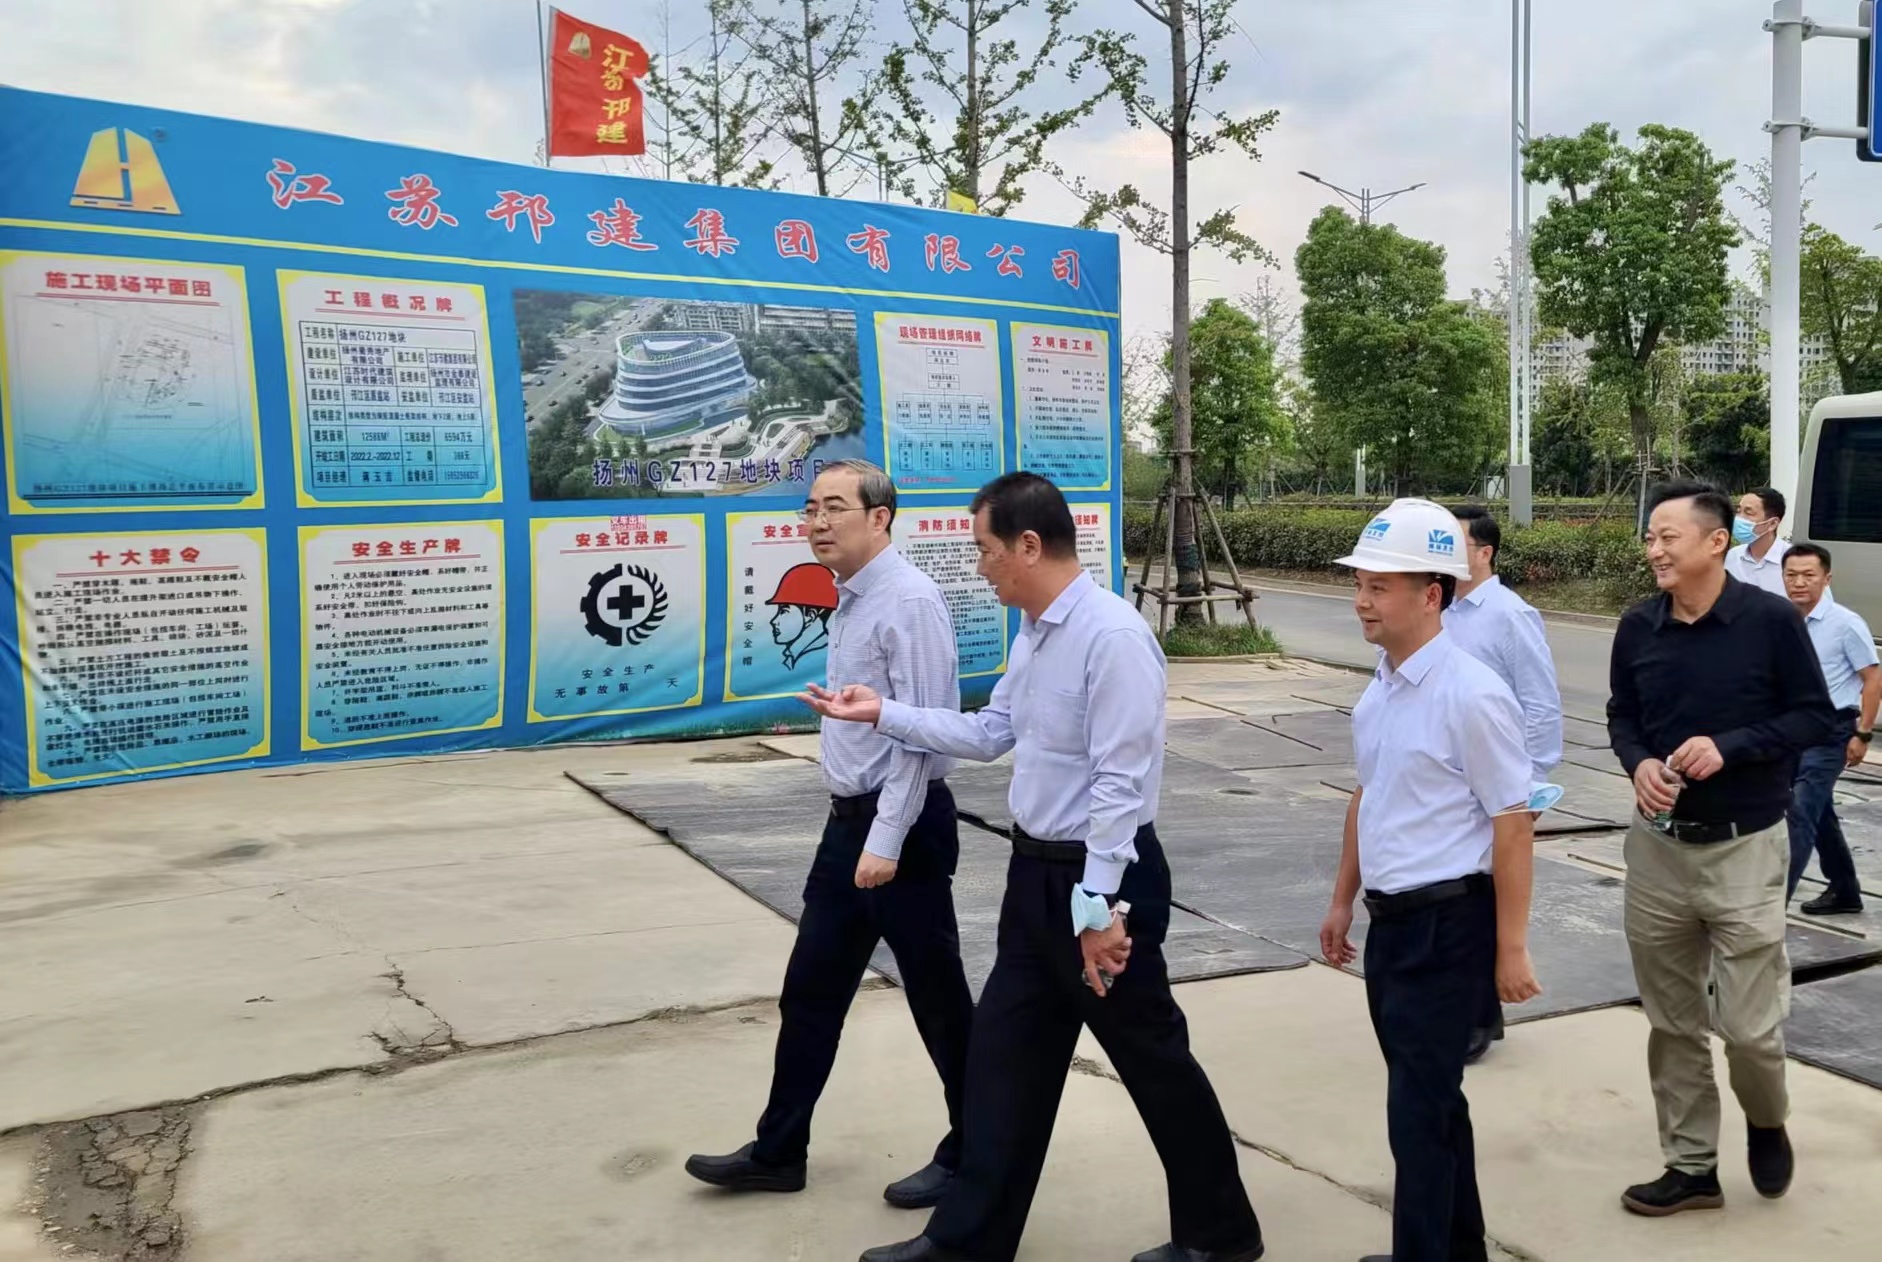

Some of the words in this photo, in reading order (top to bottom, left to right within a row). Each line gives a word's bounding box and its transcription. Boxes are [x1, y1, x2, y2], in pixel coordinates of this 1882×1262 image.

[266, 157, 1082, 290] 江苏邗建集团有限公司
[45, 271, 212, 297] 施工现场平面图
[324, 290, 453, 312] 工程概况牌
[1032, 335, 1093, 352] 文明施工牌
[352, 538, 461, 557] 安全生产牌
[576, 530, 668, 547] 安全记录牌
[89, 547, 200, 567] 十大禁令
[742, 567, 754, 666] 请戴好安全帽
[581, 663, 655, 679] 安全生产
[555, 682, 630, 698] 无事故第
[667, 677, 678, 688] 天
